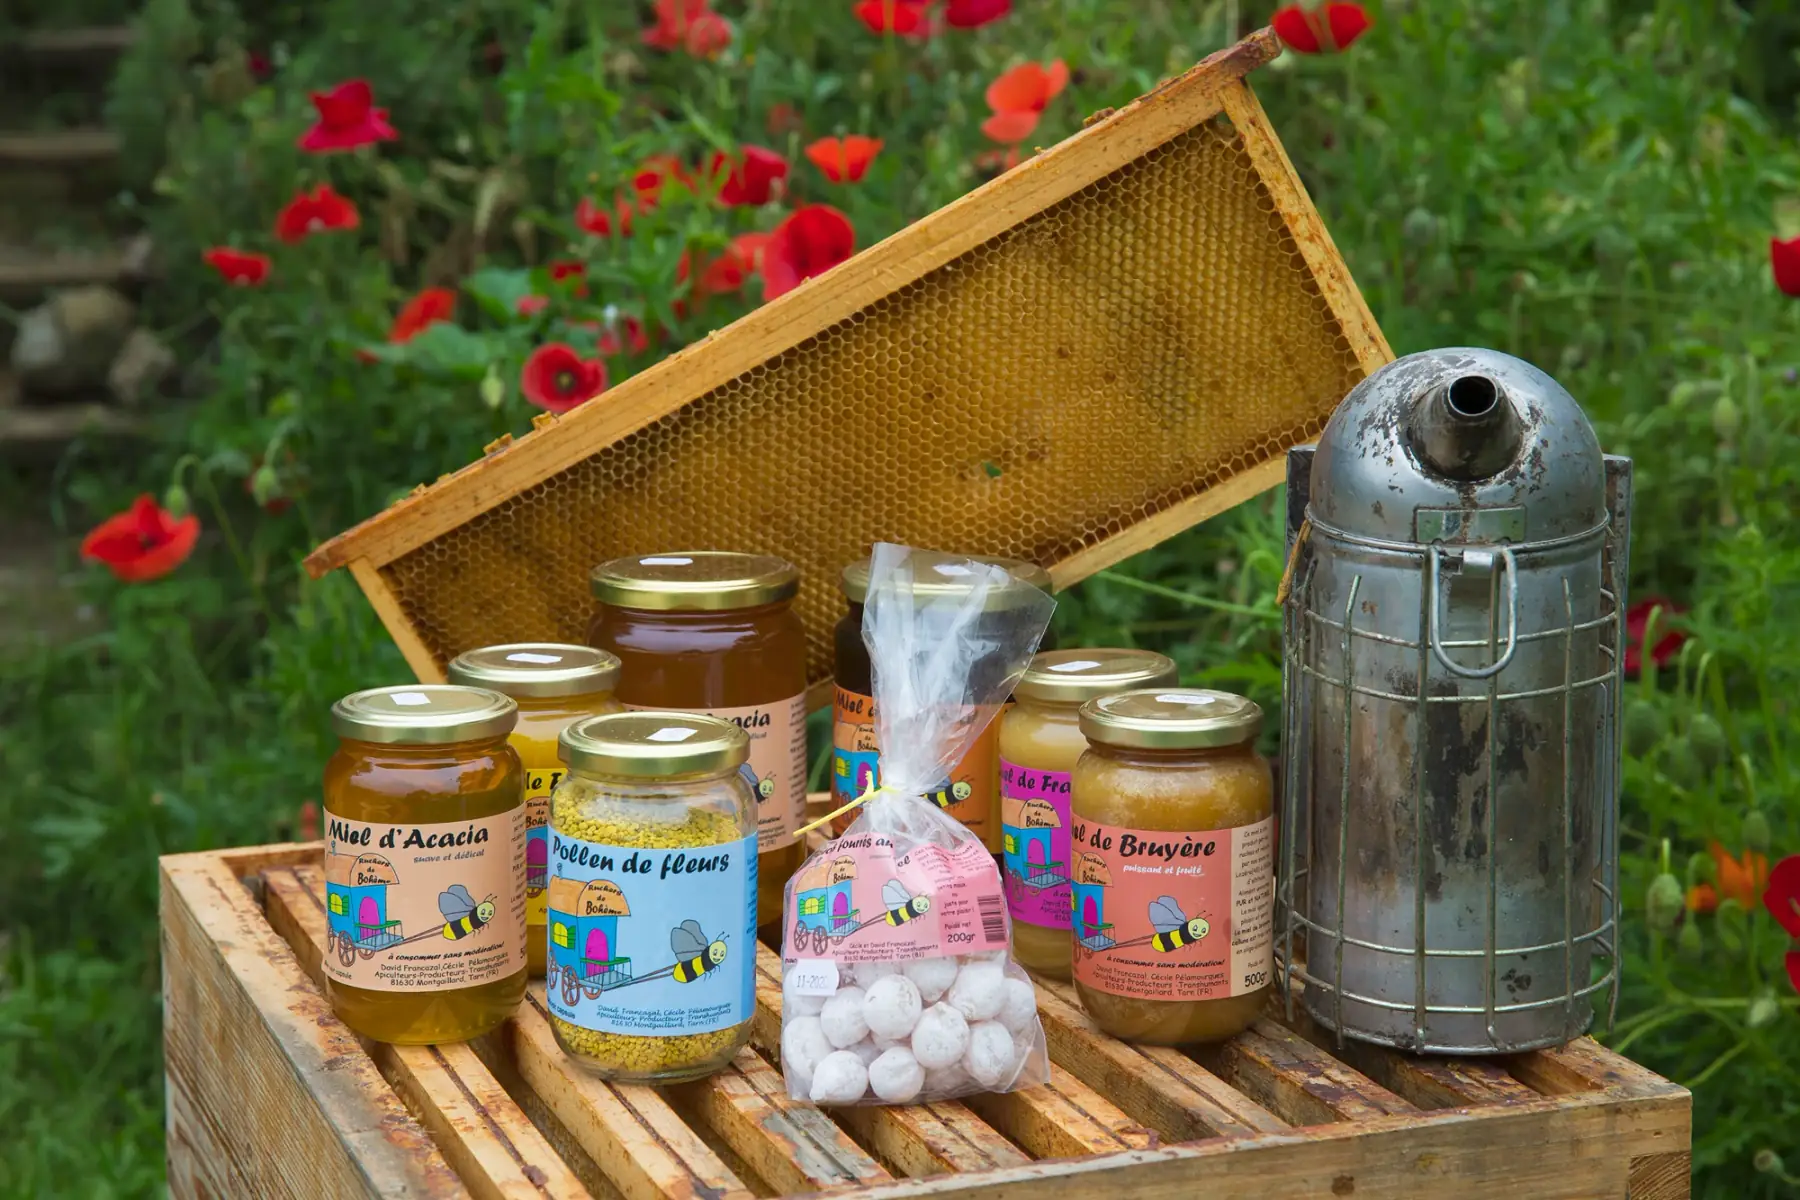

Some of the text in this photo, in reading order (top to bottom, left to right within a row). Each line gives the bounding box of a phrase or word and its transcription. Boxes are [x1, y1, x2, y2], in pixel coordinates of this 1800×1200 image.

[1018, 771, 1035, 789] de
[1026, 803, 1055, 811] Ruchers
[1026, 816, 1055, 827] Bohème
[329, 819, 371, 846] Miel
[379, 824, 488, 849] d'Acacia
[1090, 828, 1112, 850] de
[1119, 834, 1216, 862] Bruyère
[358, 857, 391, 867] Ruchers
[443, 853, 451, 861] et
[553, 835, 614, 872] Pollen
[622, 852, 652, 874] de
[660, 853, 730, 880] fleurs
[1123, 864, 1203, 876] puissant et fruité
[357, 872, 391, 885] Bohème
[833, 873, 854, 884] Bohème
[1082, 871, 1107, 885] Bohème
[588, 884, 622, 896] Ruchers
[586, 901, 622, 915] Bohème
[947, 932, 975, 943] 200gr
[395, 953, 441, 961] consommer
[1112, 957, 1155, 967] consommer
[380, 963, 402, 971] David
[486, 968, 499, 979] (FR)
[1151, 972, 1173, 981] Cécile
[1177, 988, 1194, 996] Tarn
[1197, 988, 1213, 997] (FR)
[597, 1004, 619, 1013] David
[664, 1008, 686, 1016] Cécile
